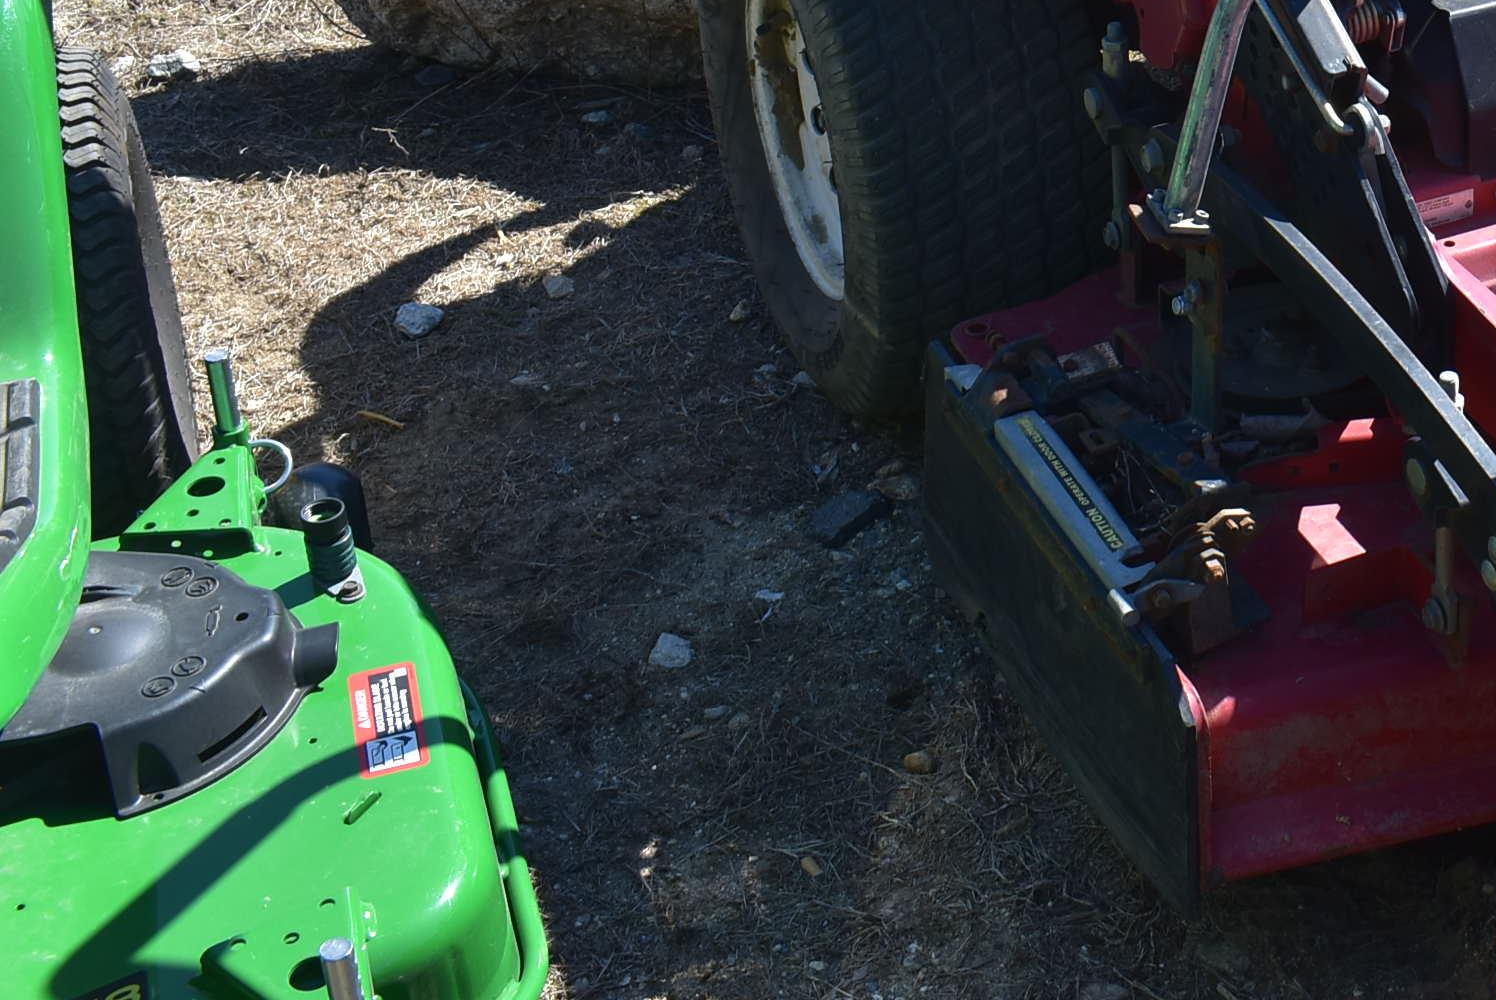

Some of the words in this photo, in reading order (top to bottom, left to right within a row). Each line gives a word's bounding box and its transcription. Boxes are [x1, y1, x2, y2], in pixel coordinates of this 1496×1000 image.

[1038, 442, 1057, 461] DOOR
[1051, 459, 1070, 478] WITH
[1064, 475, 1091, 507] OPERATE
[1086, 507, 1124, 550] CAUTION
[355, 689, 368, 718] DANGER
